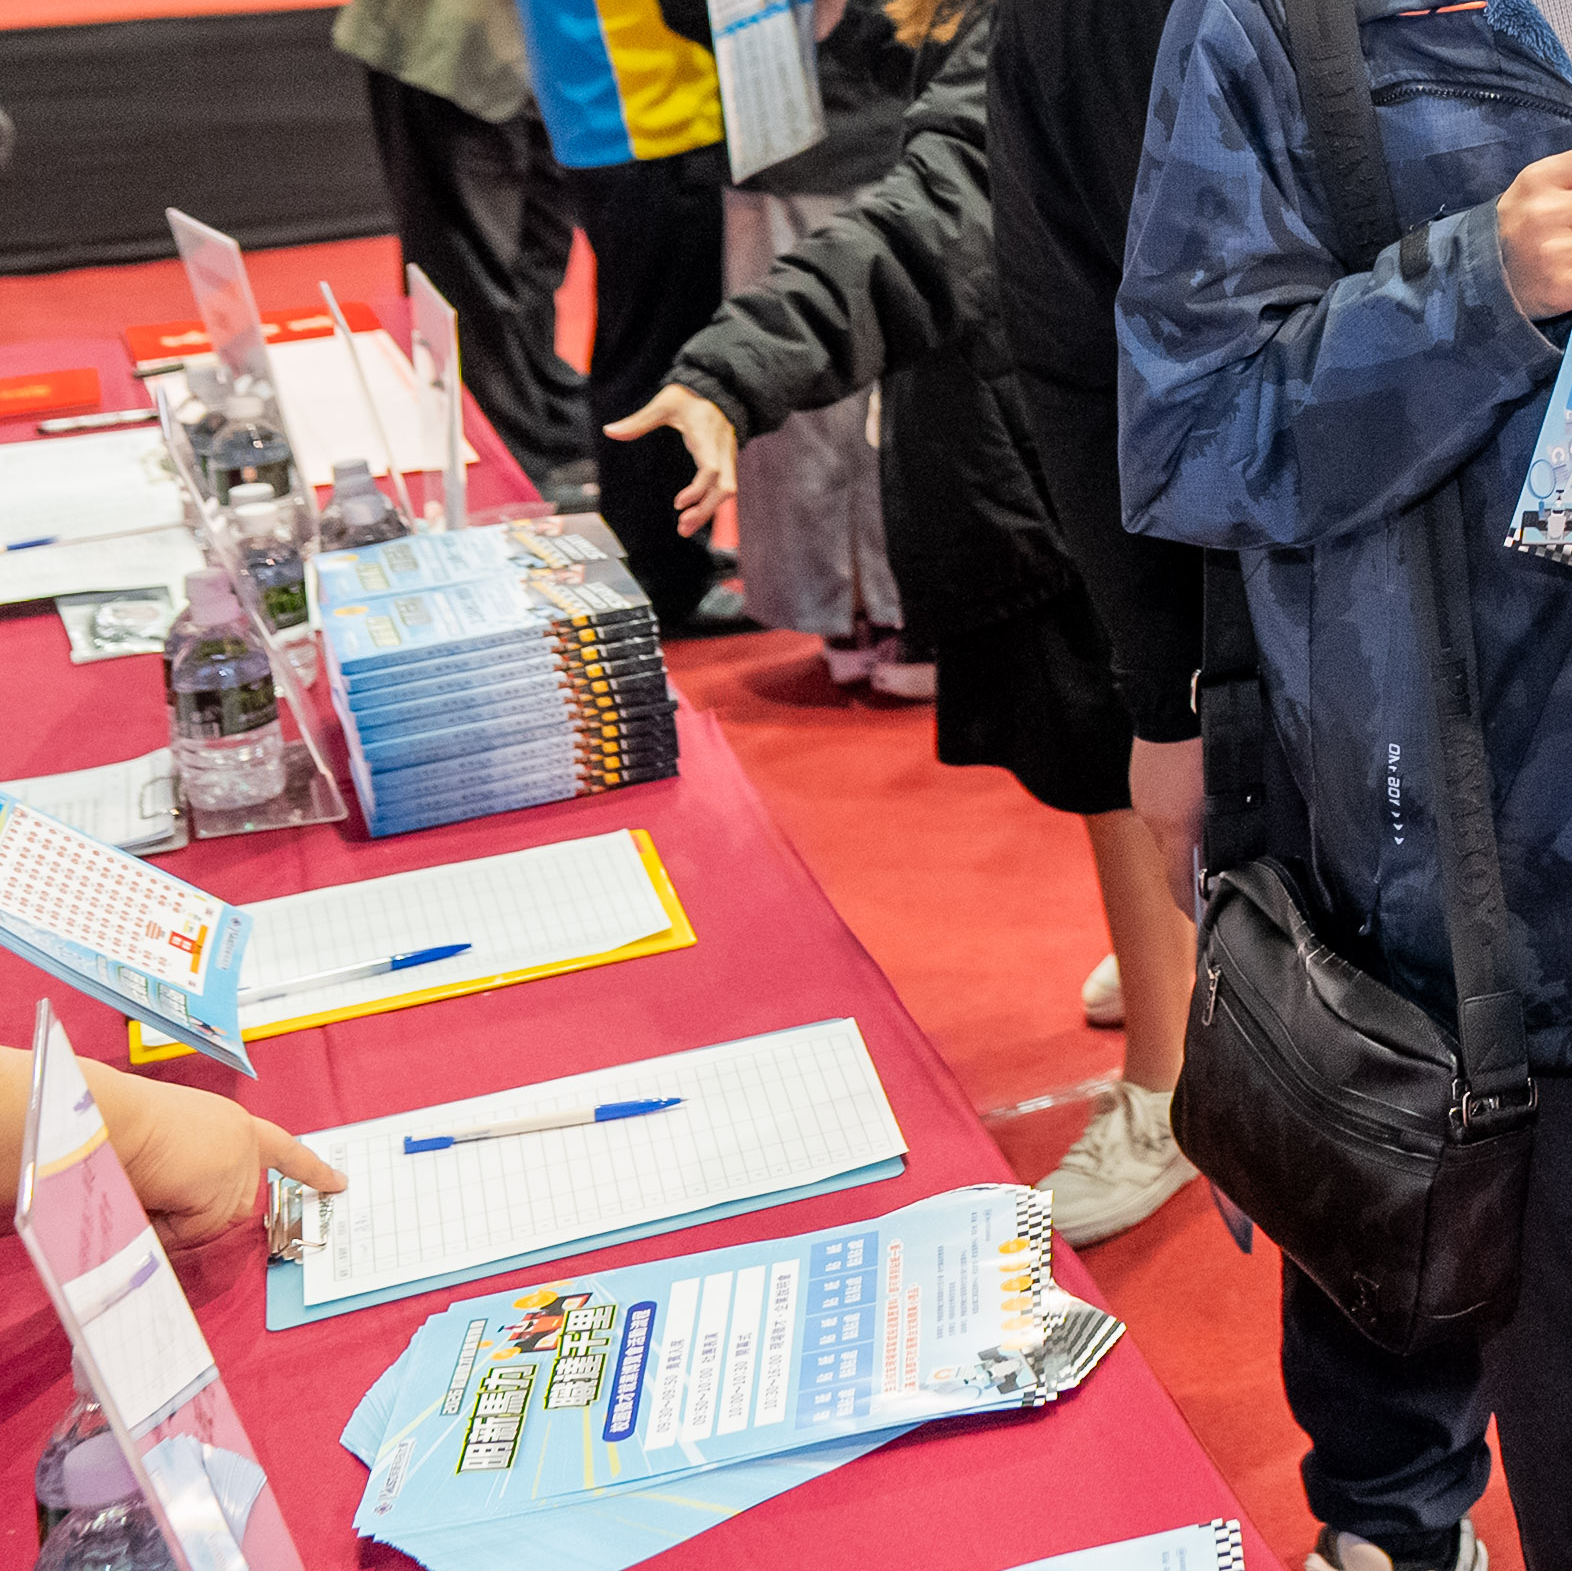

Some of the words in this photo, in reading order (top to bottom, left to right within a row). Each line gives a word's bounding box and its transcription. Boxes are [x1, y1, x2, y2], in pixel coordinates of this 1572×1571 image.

[546, 1306, 615, 1409] 職達千里
[458, 1365, 537, 1472] 明新馬力
